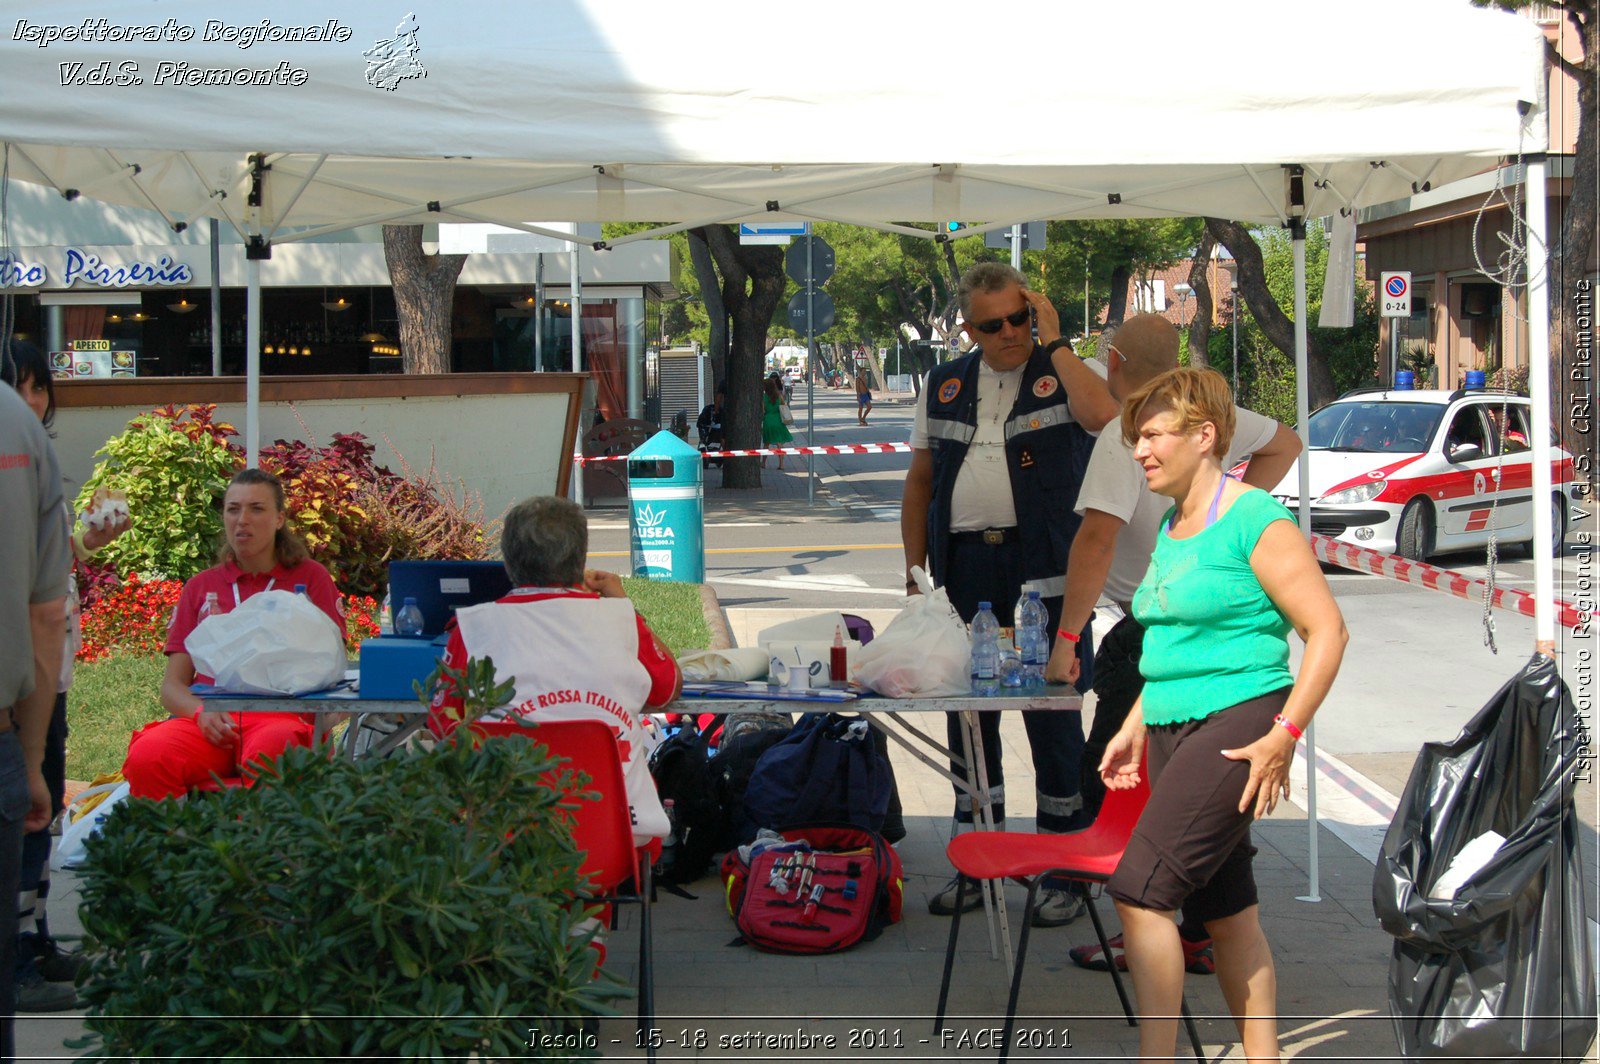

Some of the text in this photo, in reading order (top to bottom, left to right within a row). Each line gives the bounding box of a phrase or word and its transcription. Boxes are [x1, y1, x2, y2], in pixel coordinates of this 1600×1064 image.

[65, 250, 188, 284] Pizzeria
[1385, 302, 1406, 311] 0-24
[75, 340, 108, 350] APERTO
[632, 526, 675, 538] ALISEA
[537, 689, 582, 708] ROSSA
[586, 691, 633, 731] ITALIANA
